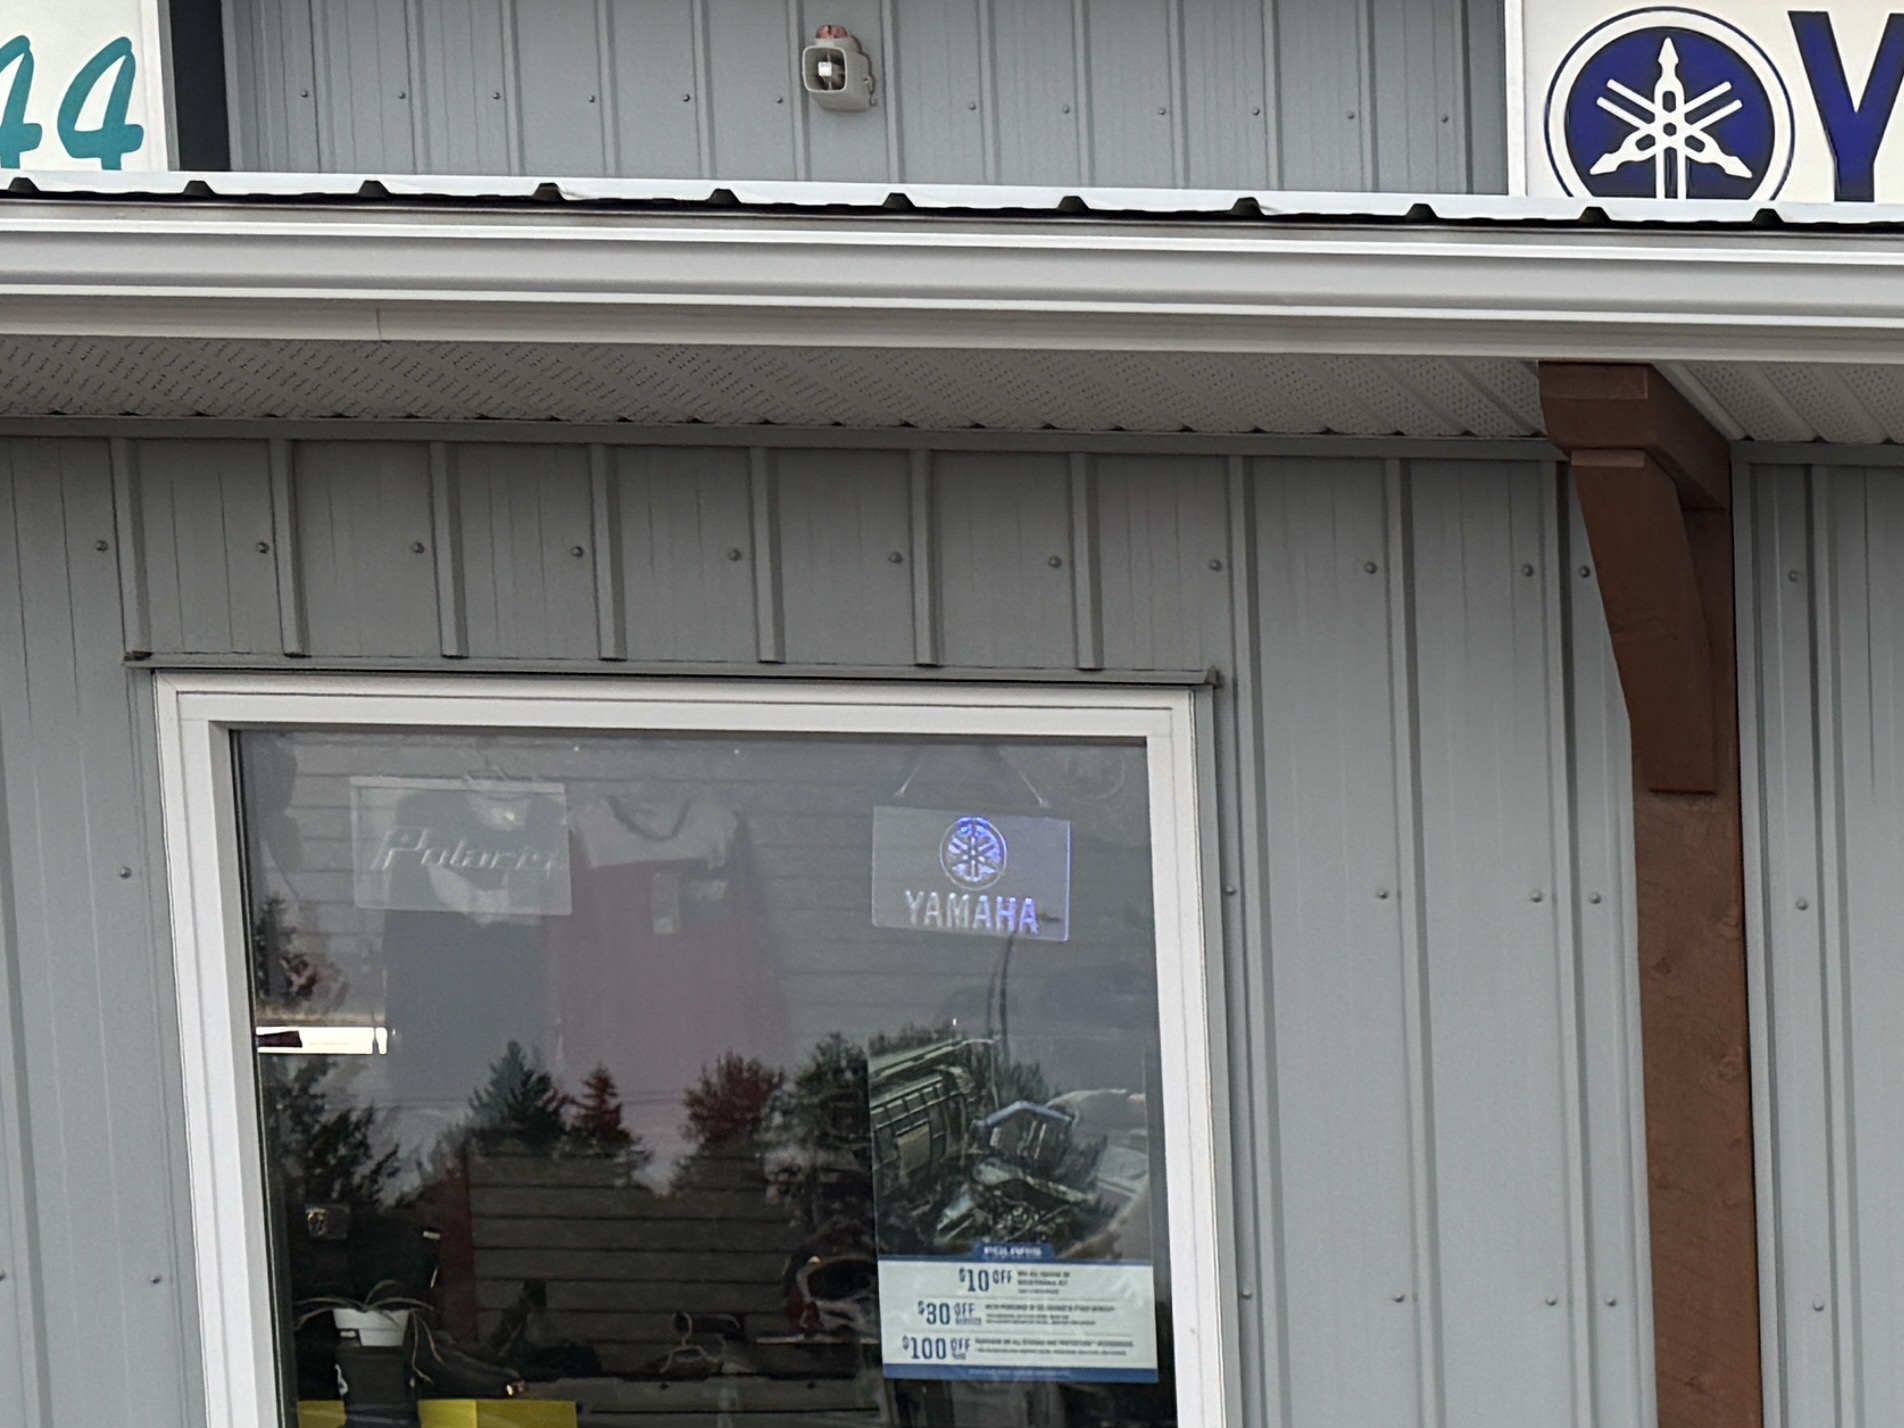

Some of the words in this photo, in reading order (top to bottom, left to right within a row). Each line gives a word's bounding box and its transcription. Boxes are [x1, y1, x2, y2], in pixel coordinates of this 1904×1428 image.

[904, 889, 1040, 934] YAMAHA
[959, 1267, 990, 1292] $10
[993, 1270, 1013, 1284] OFF
[918, 1300, 950, 1325] $30
[955, 1302, 975, 1316] OFF
[902, 1335, 947, 1360] $100
[951, 1338, 970, 1351] OFF
